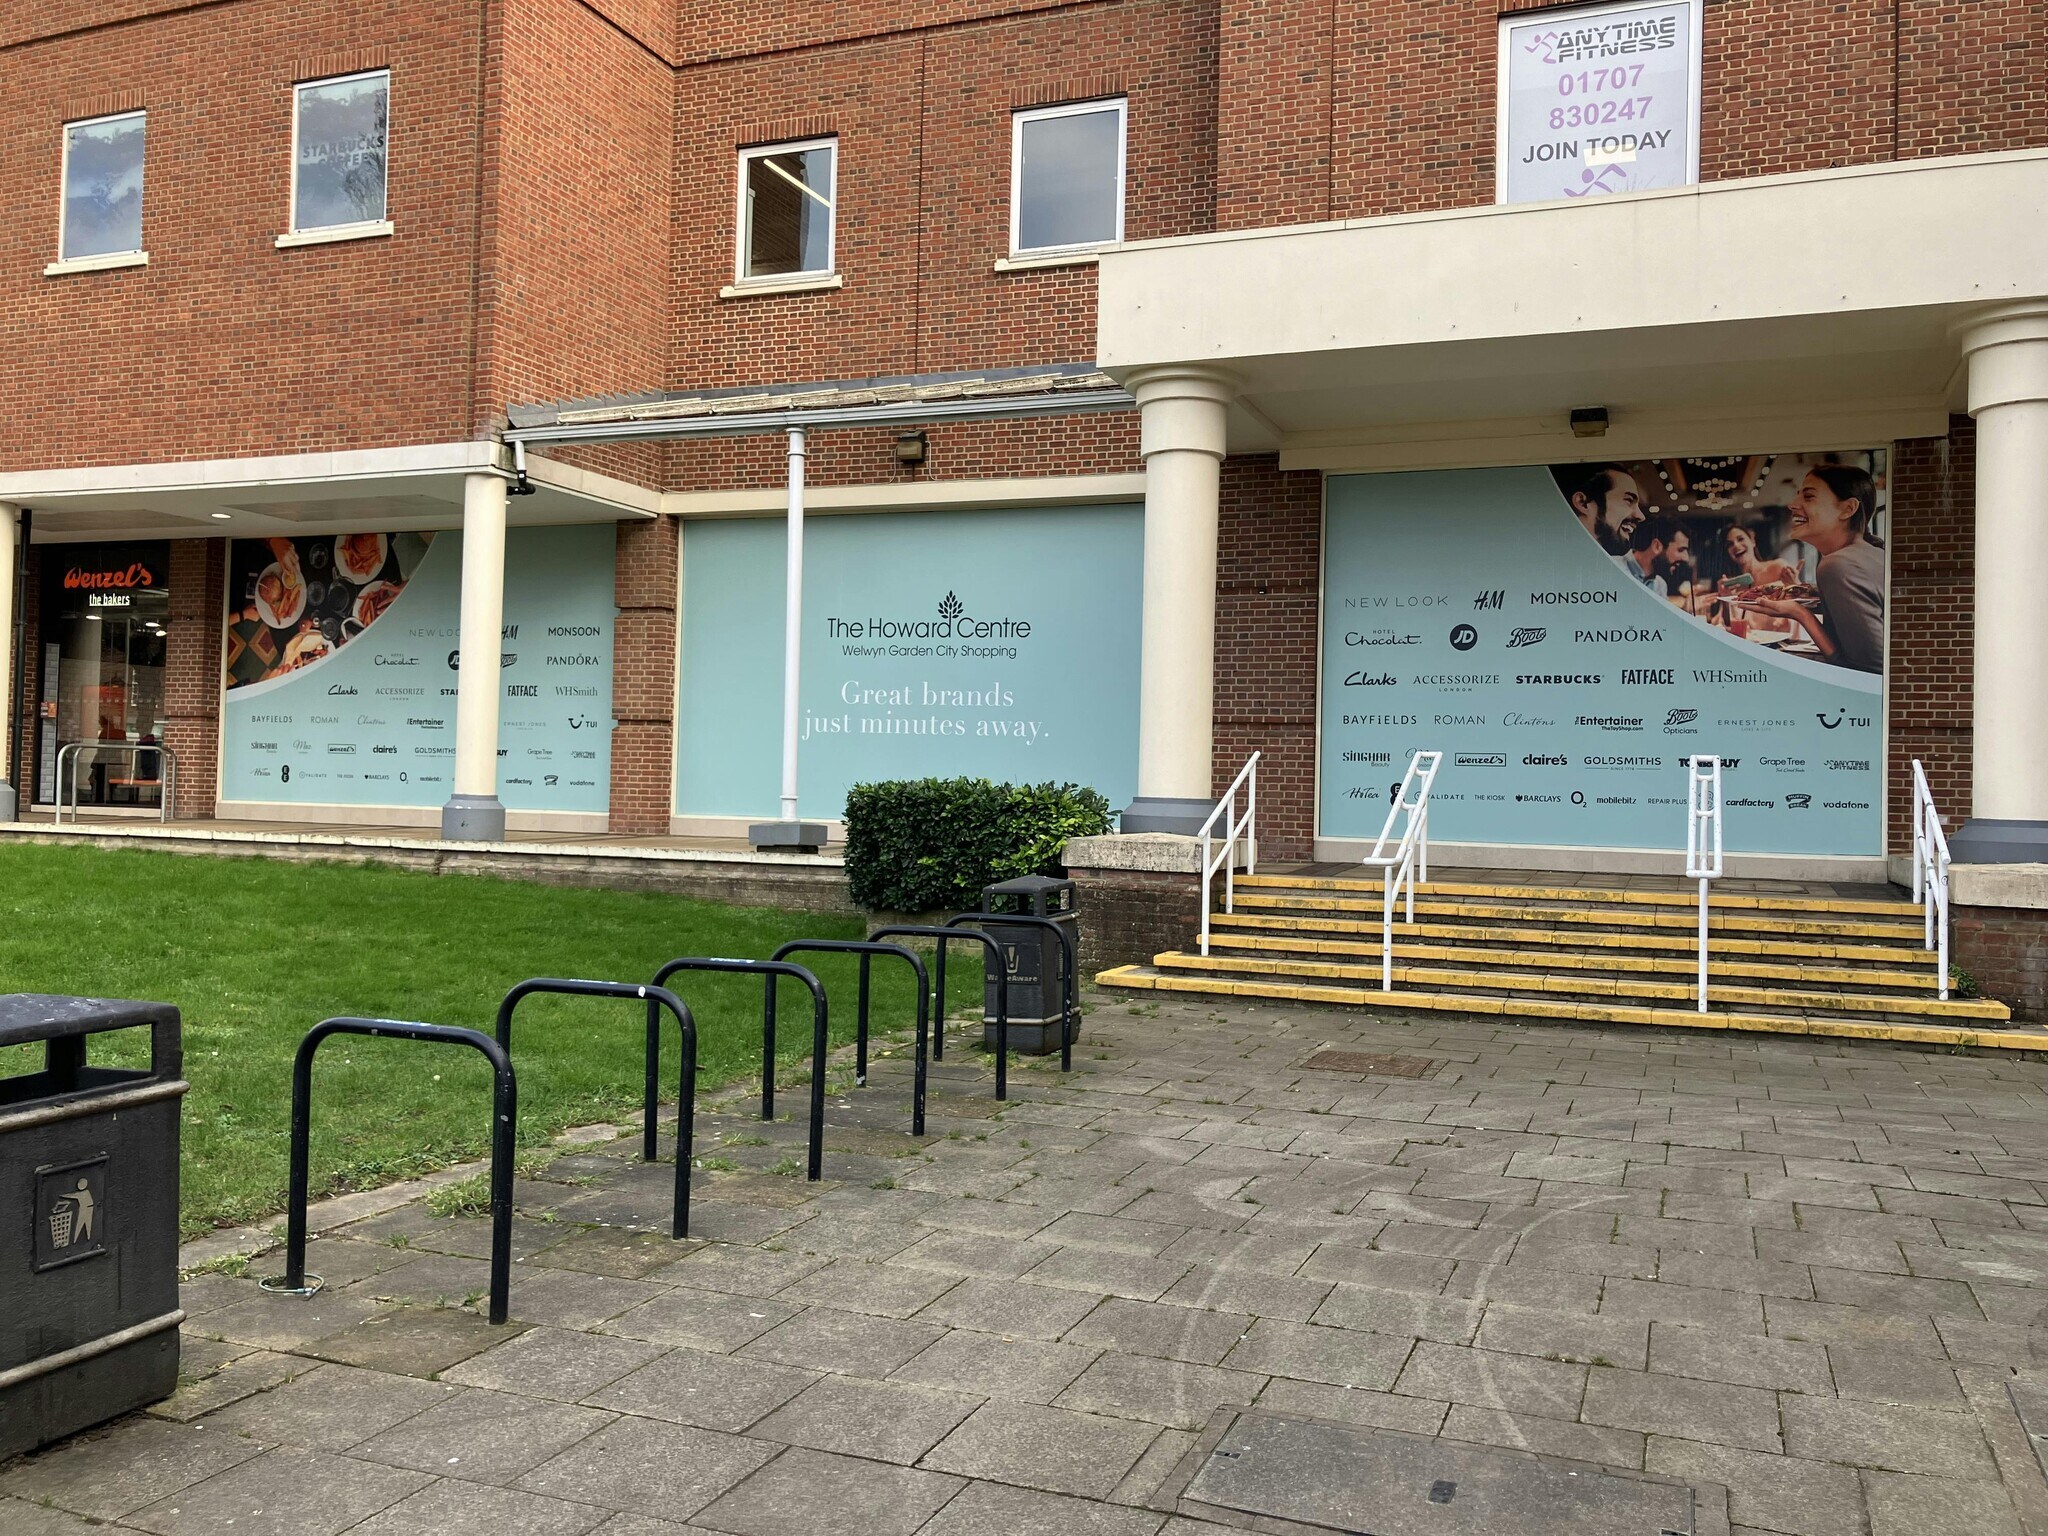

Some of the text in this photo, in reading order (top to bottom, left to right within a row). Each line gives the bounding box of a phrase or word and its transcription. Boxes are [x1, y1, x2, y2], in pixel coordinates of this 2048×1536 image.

[1557, 16, 1676, 49] ANYTIME
[1558, 34, 1675, 63] FITNESS
[1558, 64, 1645, 96] 01707
[1549, 96, 1653, 130] 830247
[303, 136, 384, 158] STARBUCKS
[1522, 129, 1672, 164] JOIN TODAY
[64, 563, 153, 589] Wenzel's
[89, 593, 130, 606] the bakers
[1345, 596, 1448, 608] NEW LOOK
[1473, 590, 1505, 610] H&M
[1531, 591, 1617, 604] MONSOON
[409, 628, 460, 637] NEW LOO
[548, 627, 600, 636] MONSOON
[828, 617, 1031, 638] The Howard Centre
[1453, 630, 1474, 644] JD
[1506, 627, 1547, 648] Boots
[1575, 627, 1663, 643] PANDORA
[842, 645, 1017, 659] Welwyn Garden City Shopping
[1344, 671, 1397, 686] Clarks
[1413, 675, 1499, 684] ACCESSORIZE
[1516, 675, 1601, 684] STARBUCKS
[1621, 669, 1675, 685] FATFACE
[1693, 670, 1767, 683] WHSmith
[328, 684, 358, 696] Clarks
[508, 685, 538, 696] FATFACE
[555, 686, 598, 696] WHSmith
[841, 681, 1014, 707] Great brands
[1434, 715, 1485, 725] ROMAN
[1503, 712, 1555, 726] Clintons
[1580, 716, 1643, 726] Entertainer
[1664, 709, 1698, 725] Boots
[1849, 718, 1870, 727] TUI
[802, 709, 1049, 745] just minutes away.
[1663, 727, 1698, 735] Opticians
[373, 746, 397, 754] claire's
[1523, 754, 1568, 765] claire's
[1584, 757, 1662, 765] GOLDSMITHS
[1760, 757, 1805, 766] Grape Tree
[1571, 791, 1587, 807] O2
[1597, 797, 1636, 805] mobilebitz
[1726, 799, 1774, 808] cardfactory
[987, 974, 1038, 982] WaeAware
